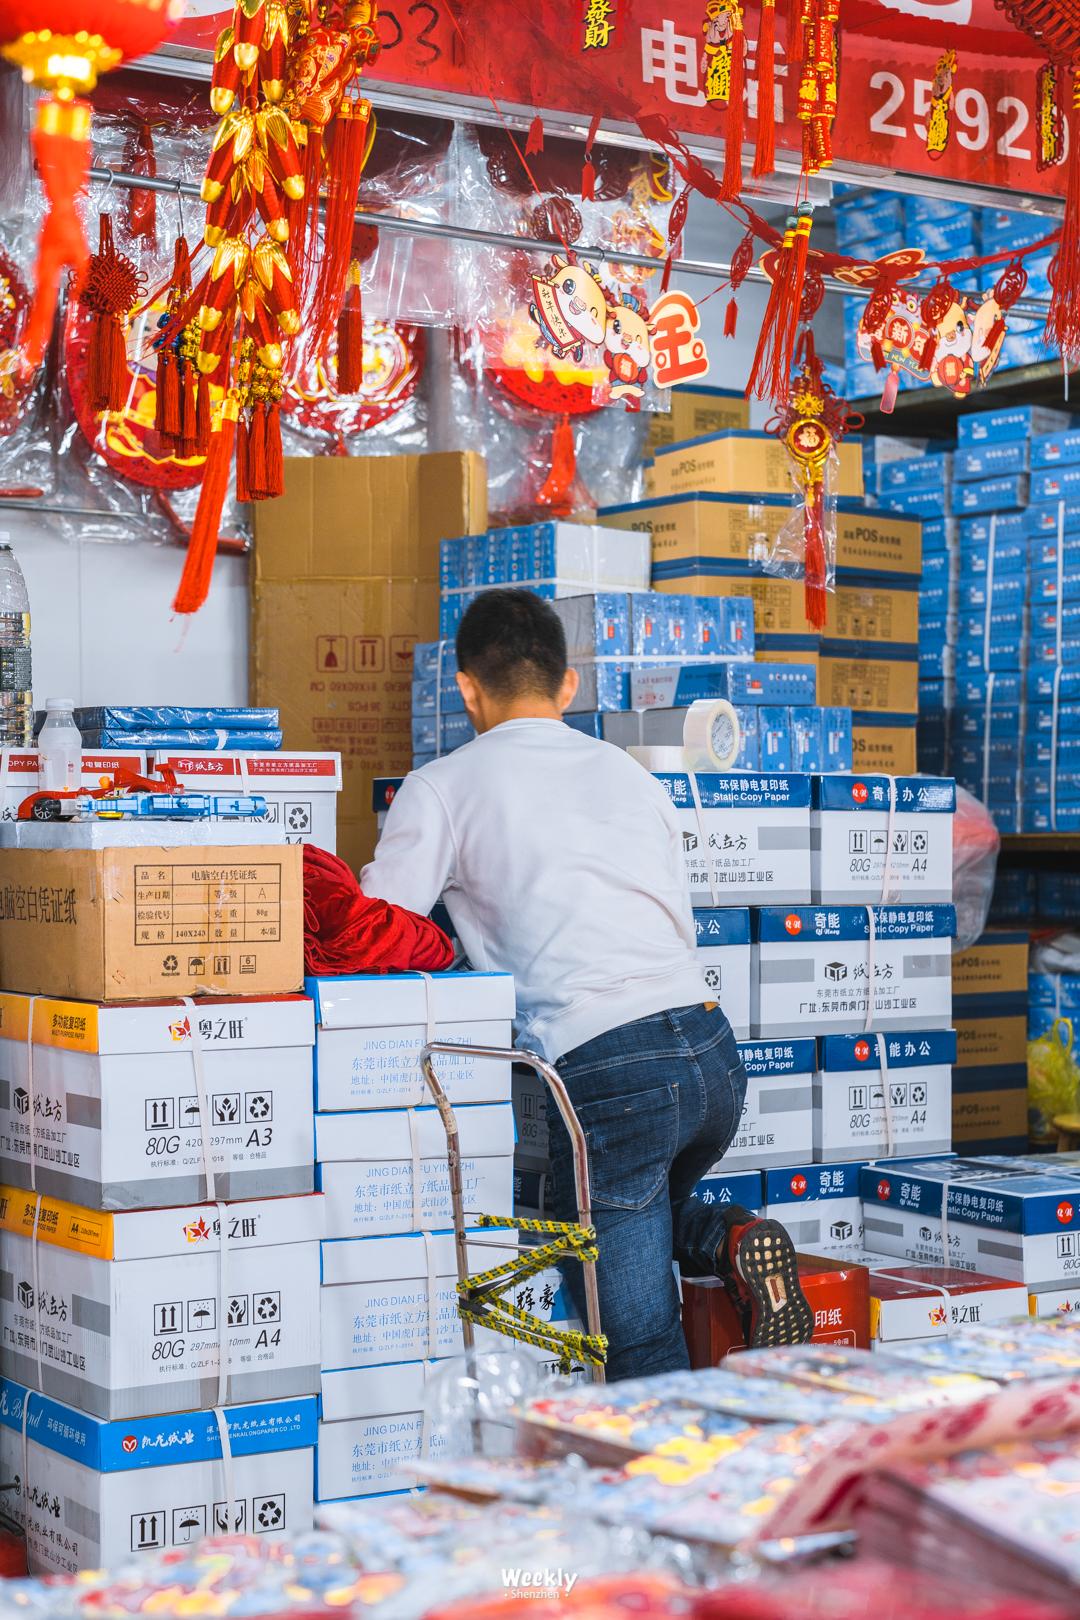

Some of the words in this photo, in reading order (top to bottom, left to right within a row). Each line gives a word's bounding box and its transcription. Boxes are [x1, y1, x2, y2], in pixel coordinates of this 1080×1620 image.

[719, 779, 789, 792] 环保静电复印纸
[713, 792, 739, 801] Static
[740, 792, 763, 802] Copy
[764, 793, 790, 802] Paper
[685, 858, 756, 868] 纸立纸品加工厂
[850, 858, 871, 872] 80G
[911, 858, 927, 872] A4
[191, 869, 257, 881] 电脑空白凭证纸
[137, 889, 170, 900] 生产日期
[258, 888, 266, 899] A
[137, 909, 170, 920] 检验代号
[814, 912, 840, 929] 奇能
[888, 924, 909, 934] Copy
[910, 923, 934, 933] Paper
[800, 998, 917, 1013] 厂址:东莞市虎门山沙工业区
[199, 1018, 245, 1040] 粤之旺
[364, 1040, 387, 1051] JING
[388, 1039, 412, 1049] DIAN
[744, 1062, 767, 1072] Copy
[768, 1060, 794, 1070] Paper
[850, 1113, 870, 1128] 80G
[911, 1110, 927, 1125] A4
[145, 1135, 180, 1155] 80G
[246, 1127, 273, 1147] A3
[366, 1167, 390, 1178] JING
[819, 1170, 845, 1187] 奇能
[900, 1182, 921, 1201] 奇能
[961, 1207, 980, 1220] Copy
[981, 1211, 1003, 1223] Paper
[365, 1297, 389, 1309] JING
[391, 1295, 415, 1305] DIAN
[815, 1307, 843, 1328] 印纸
[152, 1339, 186, 1361] 80G
[255, 1328, 281, 1349] A4
[11, 1398, 43, 1428] Brnd
[363, 1425, 388, 1437] JING
[390, 1422, 414, 1434] DIAN
